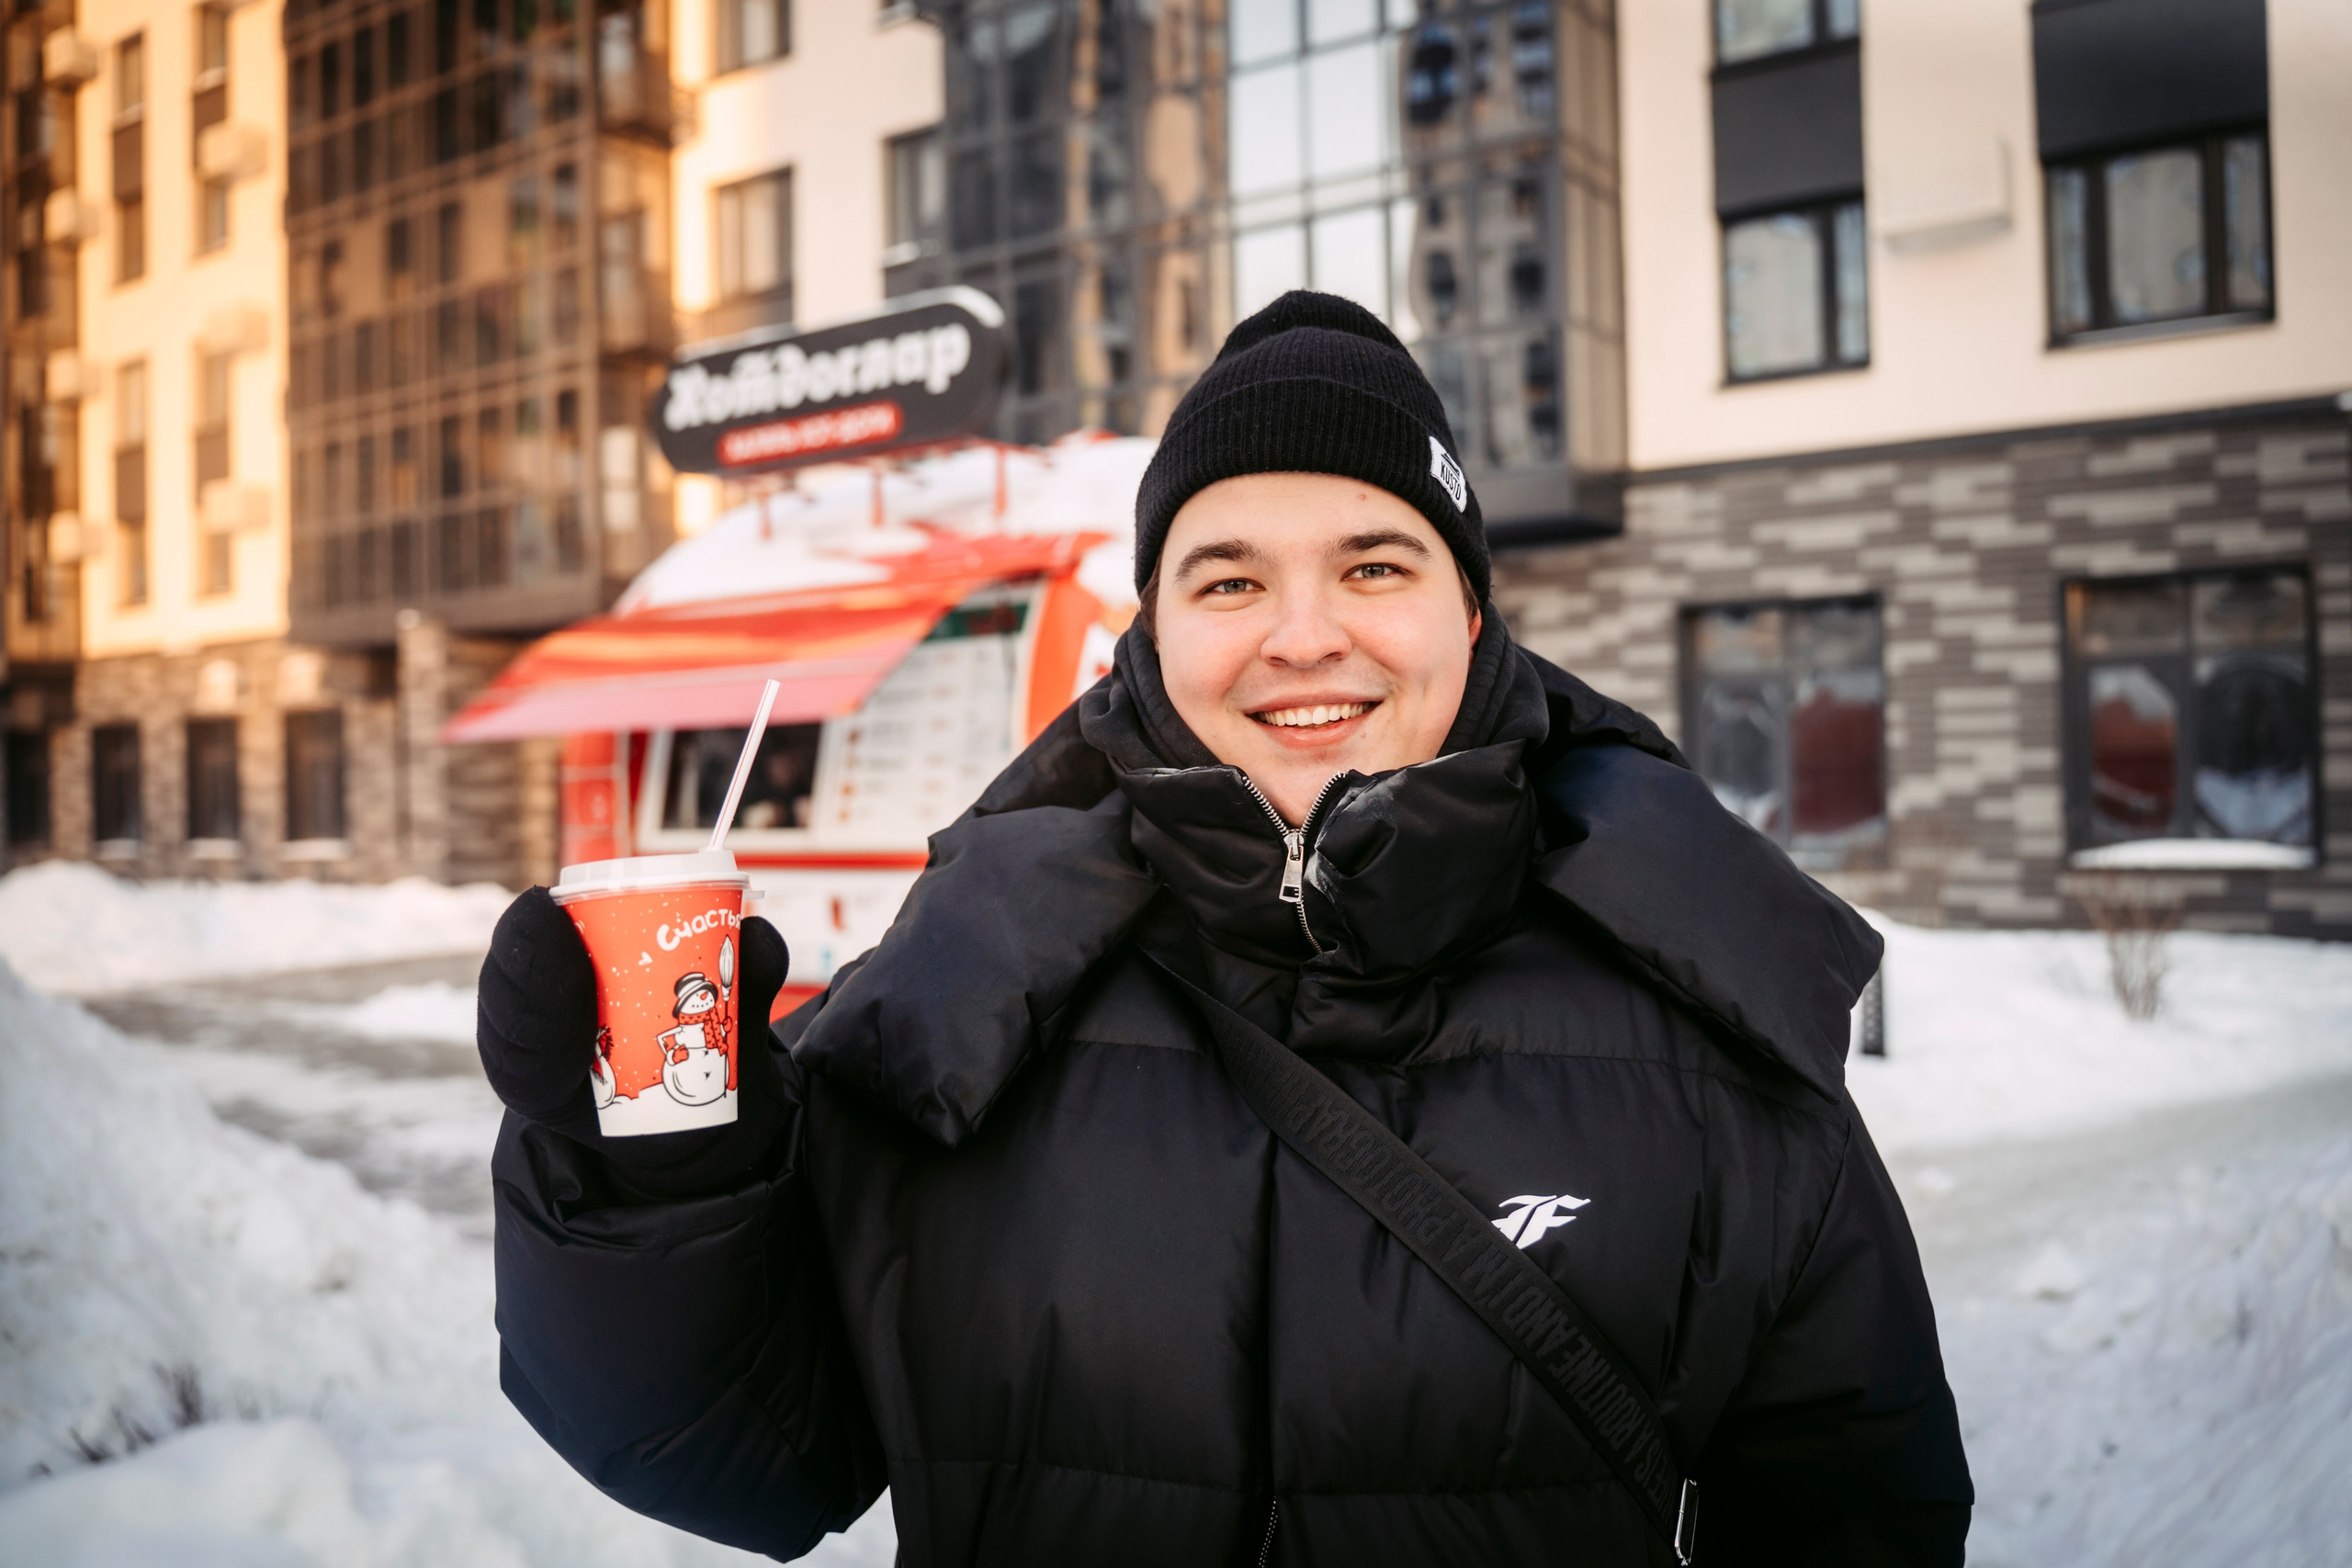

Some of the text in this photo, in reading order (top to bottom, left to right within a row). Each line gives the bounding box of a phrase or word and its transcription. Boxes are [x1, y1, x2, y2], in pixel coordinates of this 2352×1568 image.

[1440, 461, 1462, 501] KUSTO
[1438, 1219, 1486, 1264] A
[1458, 1241, 1528, 1309] I'M
[1499, 1281, 1579, 1359] AND
[1546, 1333, 1645, 1450] ROUTINE
[1622, 1420, 1655, 1463] A
[1630, 1438, 1665, 1487] IS
